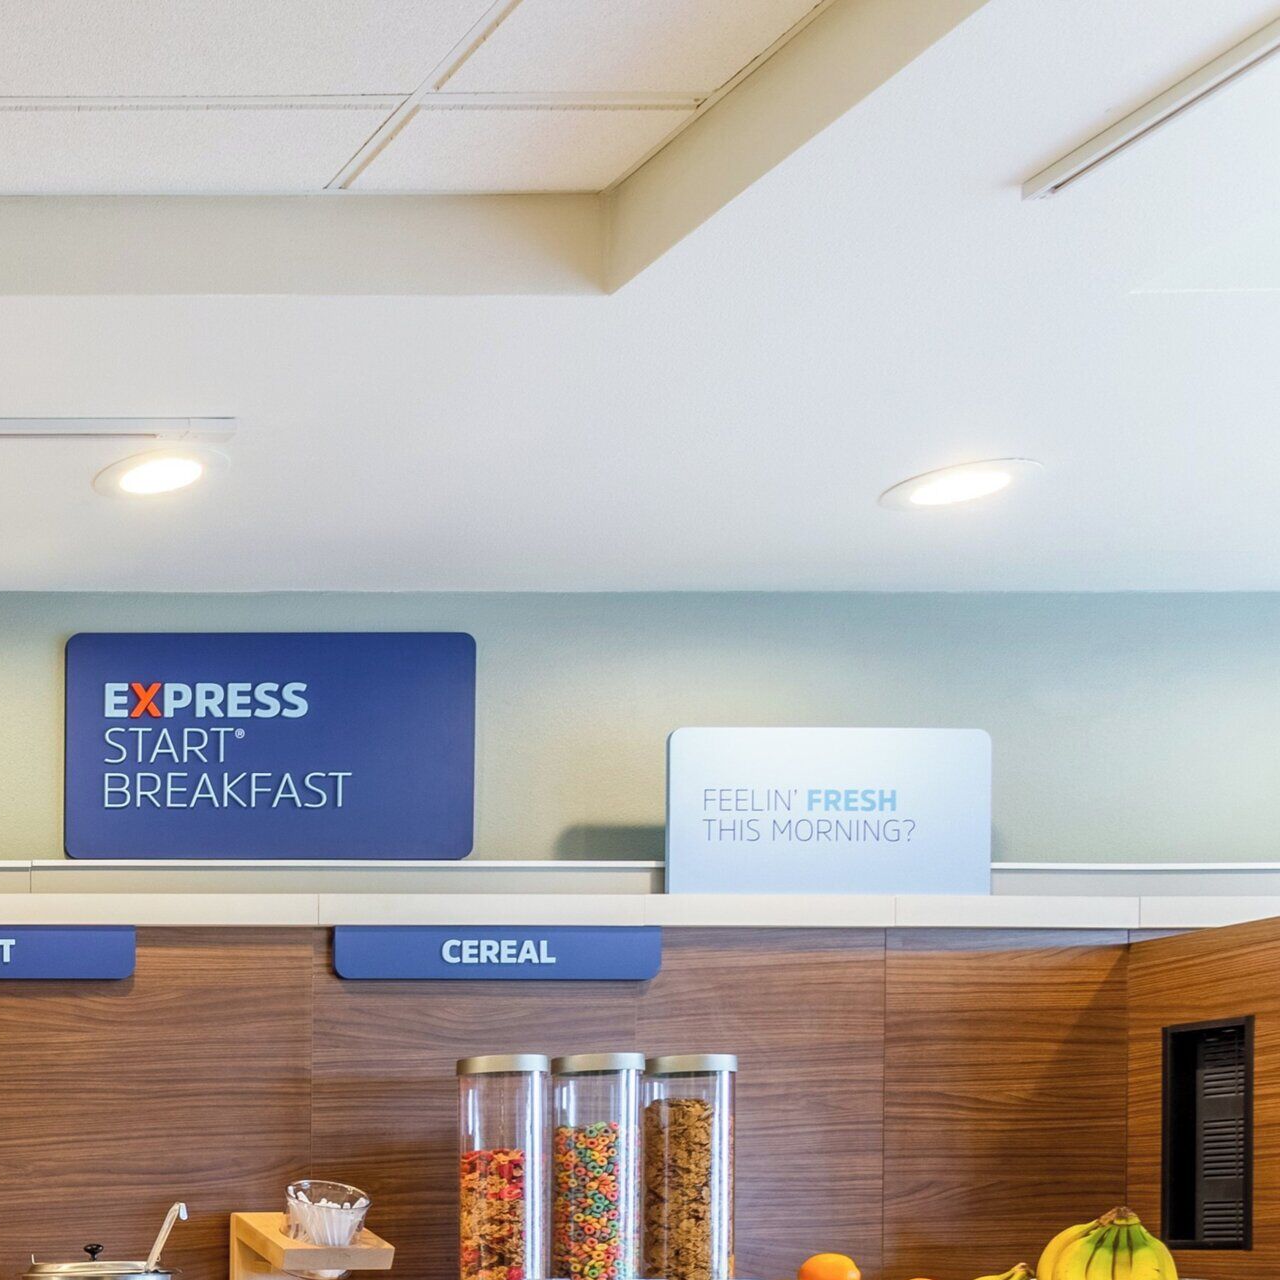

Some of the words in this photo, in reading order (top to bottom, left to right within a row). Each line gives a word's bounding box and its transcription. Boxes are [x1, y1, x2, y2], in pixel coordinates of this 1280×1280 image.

[103, 681, 308, 719] EXPRESS
[103, 771, 352, 809] BREAKFAST
[807, 789, 897, 812] FRESH
[702, 818, 761, 842] THIS
[772, 818, 916, 843] MORNING?
[441, 939, 556, 964] CEREAL
